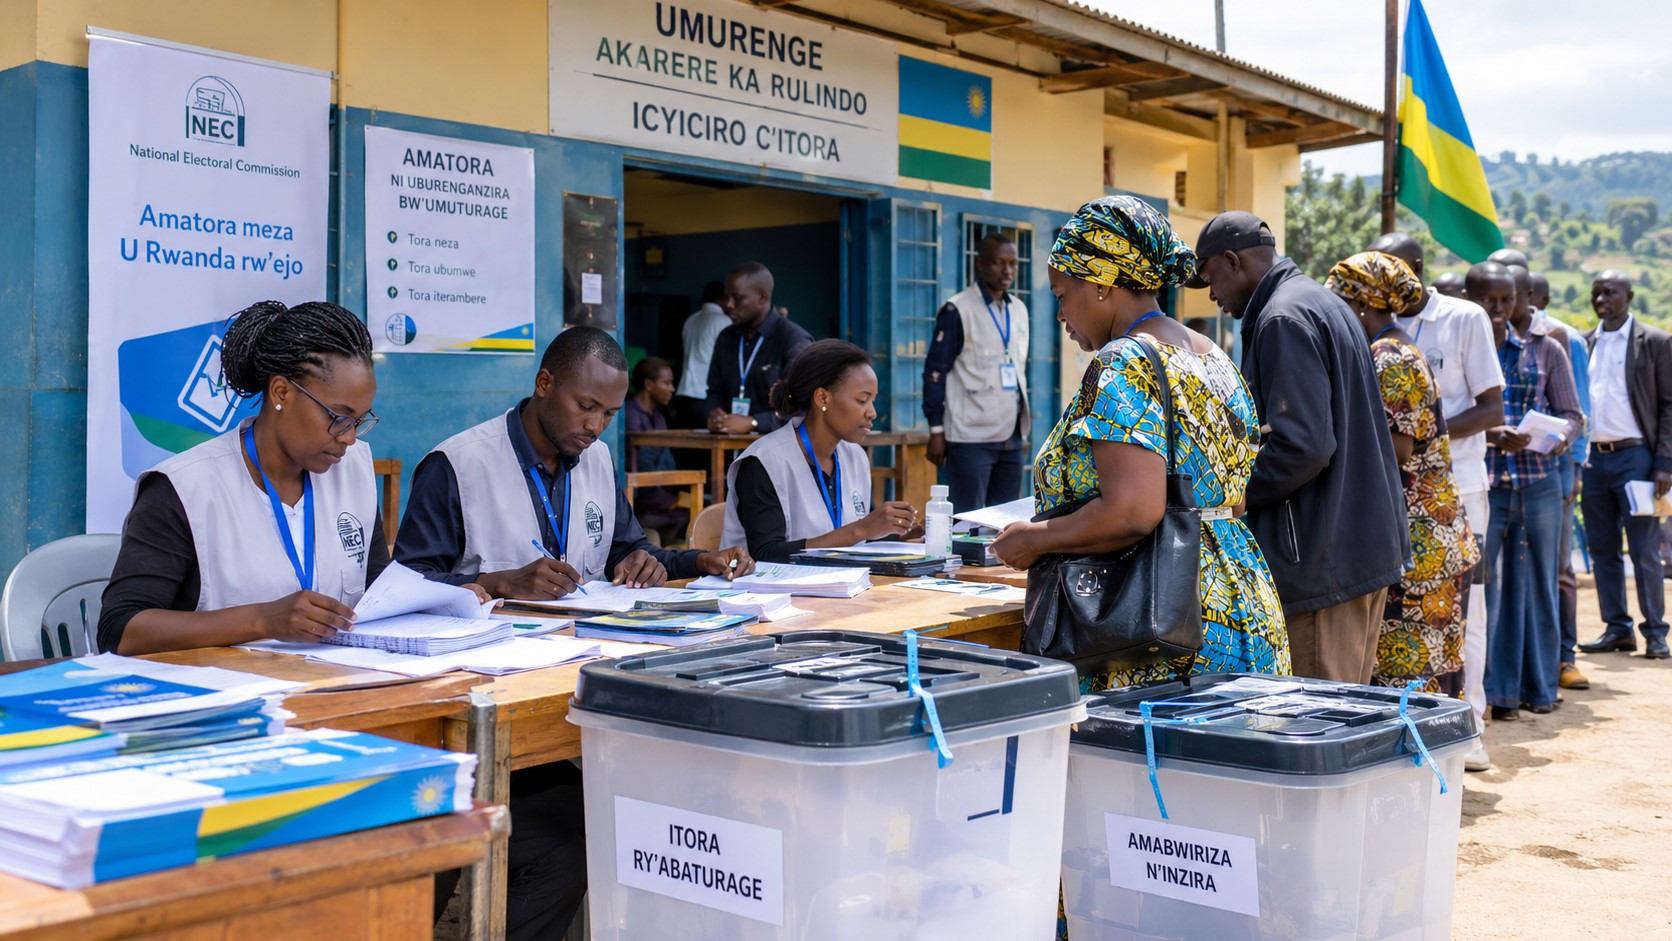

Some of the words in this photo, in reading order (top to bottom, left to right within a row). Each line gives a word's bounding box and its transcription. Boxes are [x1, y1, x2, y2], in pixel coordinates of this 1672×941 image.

[655, 2, 823, 71] UMURENGE
[596, 37, 718, 85] AKARERE
[729, 64, 760, 94] KA
[771, 73, 867, 116] RULINDO
[192, 115, 235, 140] NEC
[633, 101, 746, 147] ICYICIRO
[756, 123, 840, 163] C'ITORA
[130, 144, 180, 162] National
[184, 152, 232, 170] Electoral
[236, 160, 300, 178] Commission
[403, 148, 494, 177] AMATORA
[391, 174, 404, 187] NI
[408, 176, 510, 200] UBURENGANZIRA
[139, 204, 236, 235] Amatora
[243, 221, 293, 241] meza
[399, 195, 508, 220] BW'UMUTURAGE
[408, 233, 431, 247] Tora
[435, 239, 459, 249] neza
[120, 237, 138, 262] U
[147, 240, 235, 270] Rwanda
[242, 252, 303, 280] rw'ejo
[408, 261, 431, 274] Tora
[434, 264, 476, 278] ubumwe
[408, 289, 431, 302] Tora
[434, 290, 486, 304] iterambere
[343, 534, 361, 547] NEC
[669, 823, 721, 855] ITORA
[1128, 832, 1232, 868] AMABWIRIZA
[633, 849, 763, 901] RY'ABATURAGE
[1146, 862, 1217, 893] N'INZIRA
